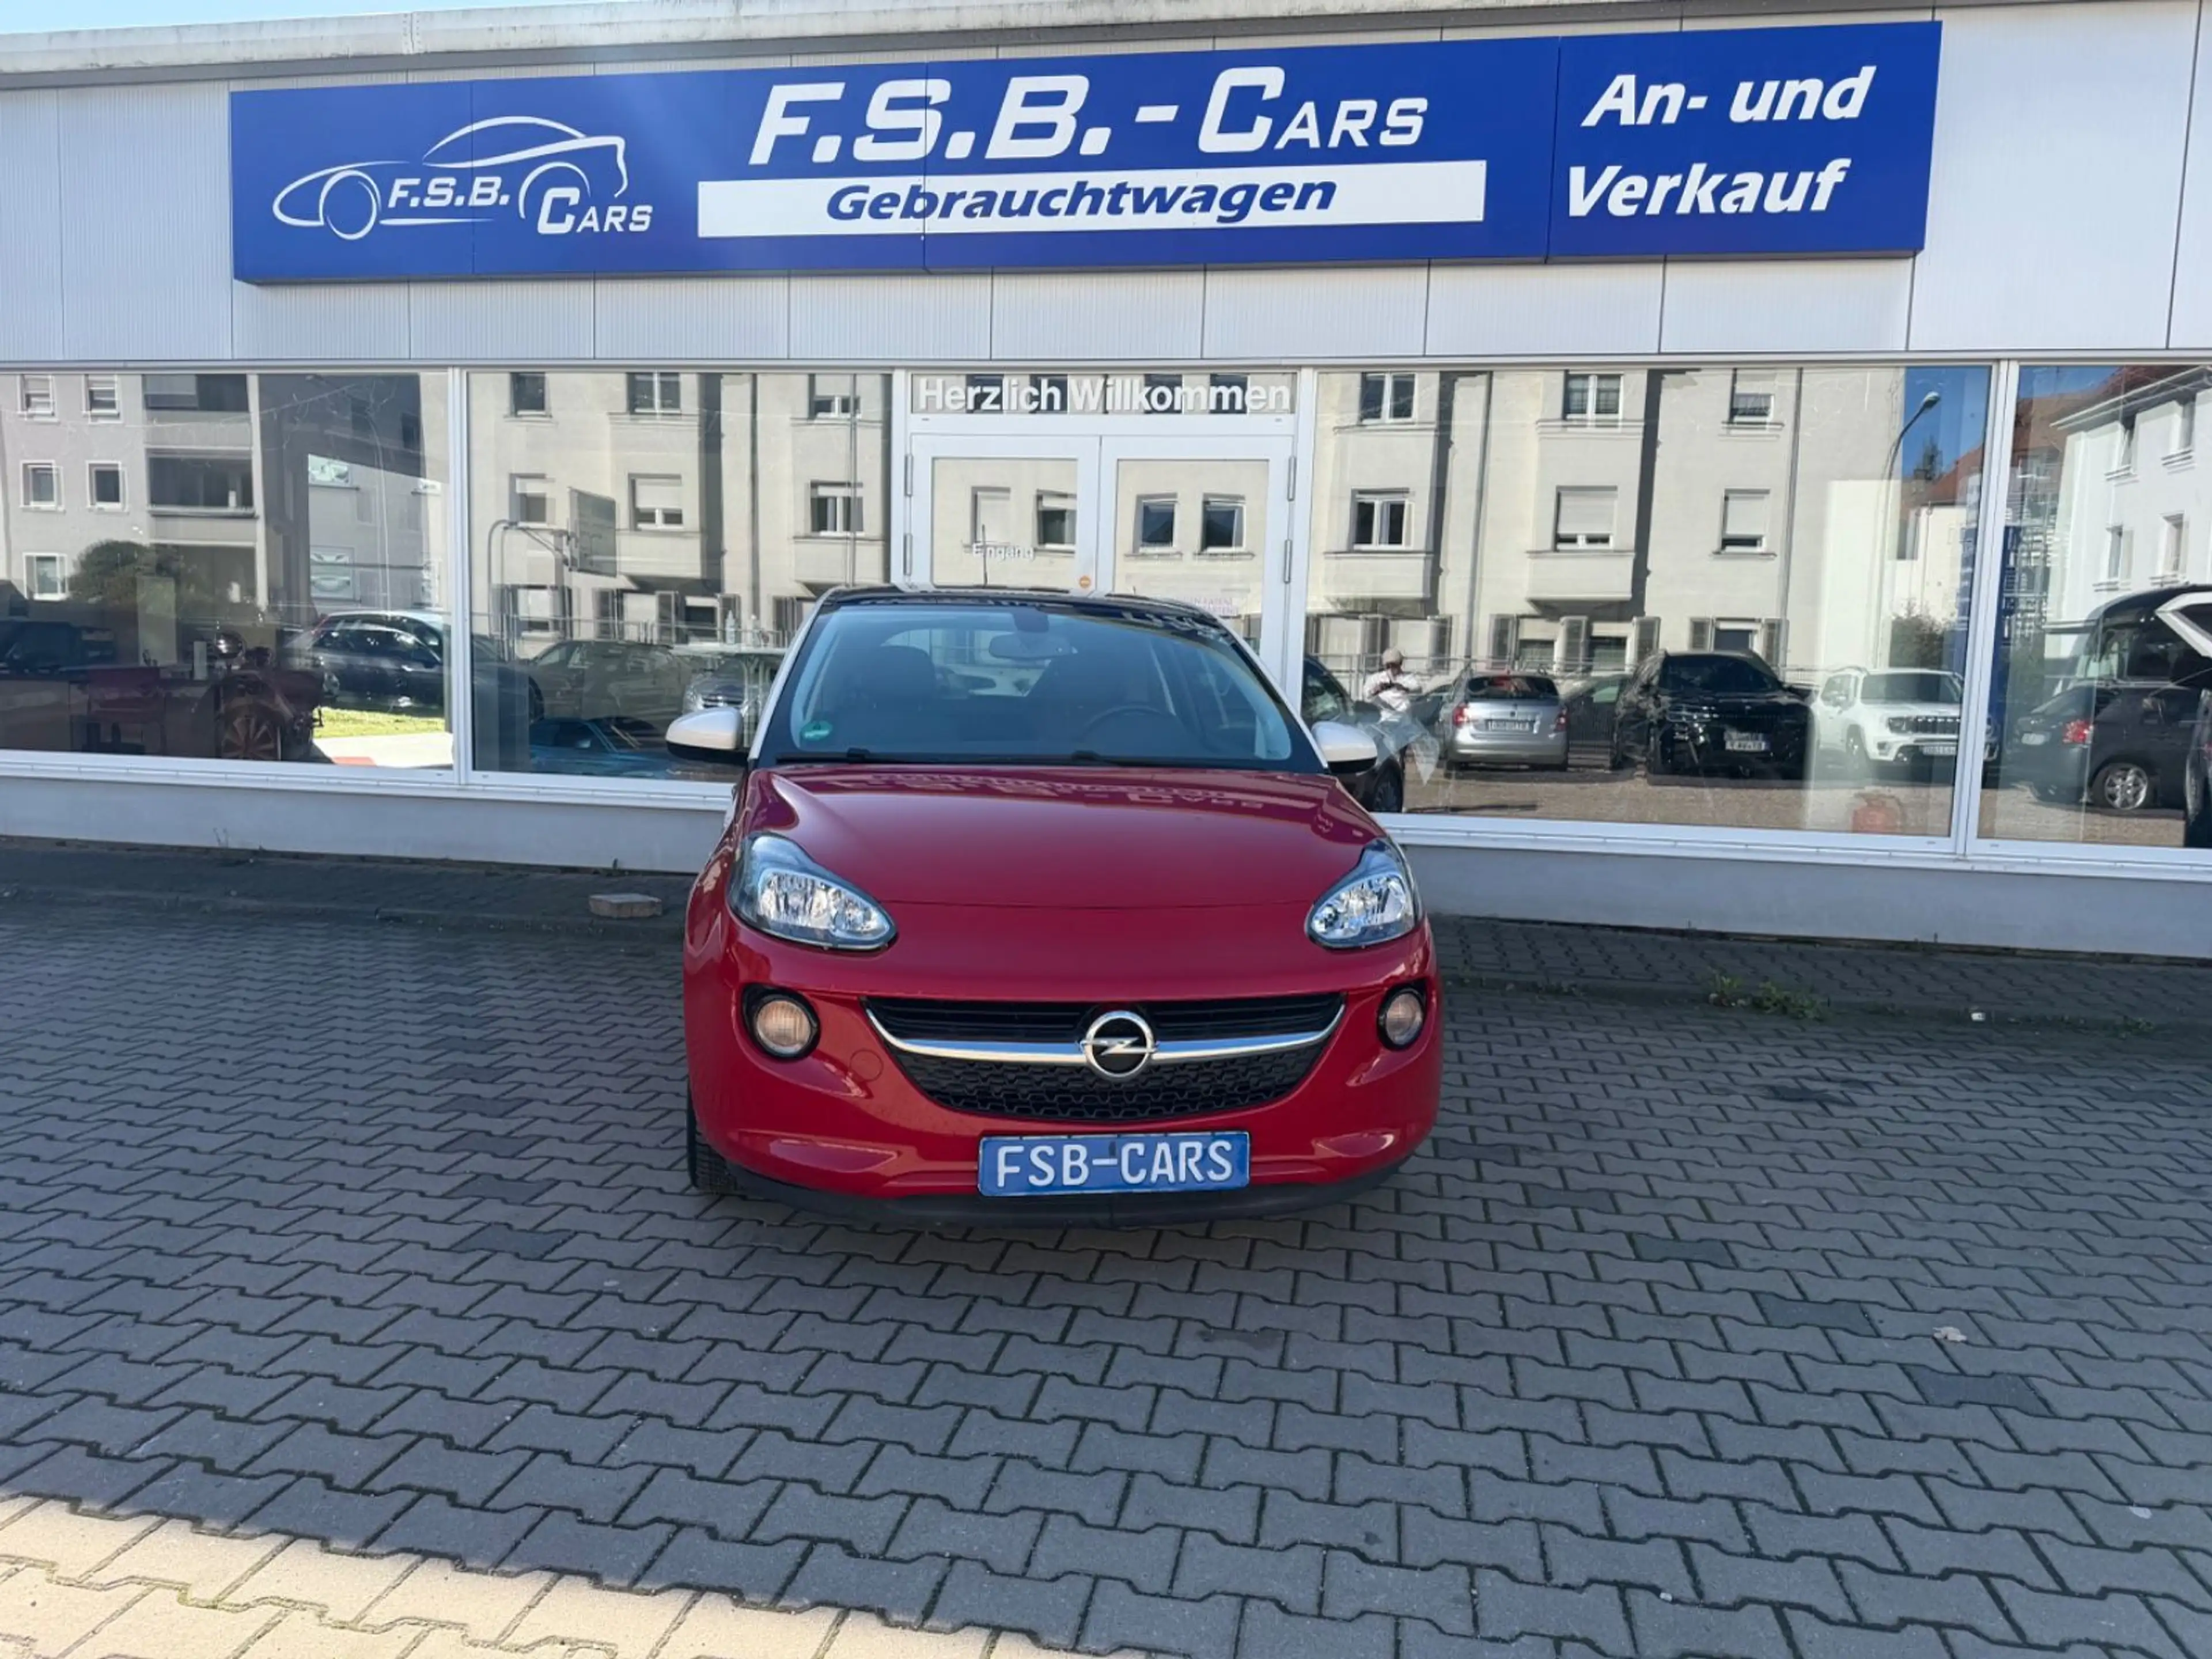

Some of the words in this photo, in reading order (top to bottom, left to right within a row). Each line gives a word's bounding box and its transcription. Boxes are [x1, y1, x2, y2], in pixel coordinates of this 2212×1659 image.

[1581, 74, 1707, 126] An-
[1730, 66, 1877, 122] und
[388, 176, 510, 208] F.S.B.
[827, 180, 1338, 225] Gebrauchtwagen
[1569, 158, 1852, 216] Verkauf
[920, 378, 1062, 410] Herzlich
[1069, 378, 1291, 411] Willkommen
[973, 541, 1035, 563] Engang
[997, 1141, 1232, 1187] FSB-CARS
